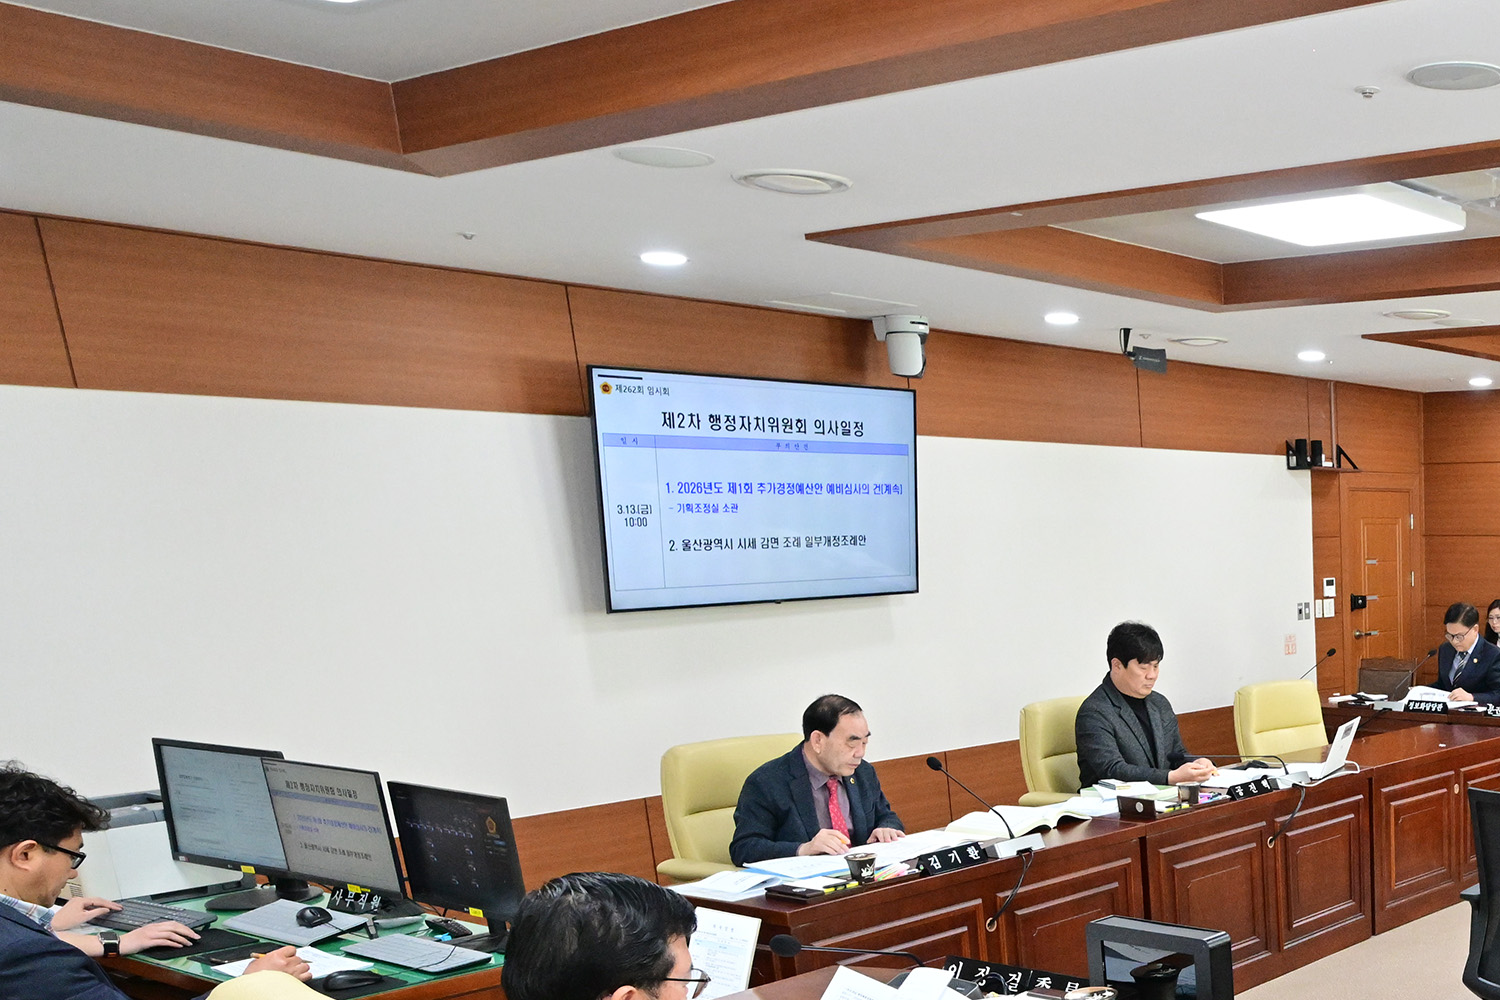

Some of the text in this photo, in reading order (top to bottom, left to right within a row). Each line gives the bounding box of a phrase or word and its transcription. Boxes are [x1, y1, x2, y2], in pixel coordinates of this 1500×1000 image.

[615, 384, 670, 396] 제262회 임시회
[661, 411, 864, 437] 제2차 행정자치위원회 의사일정
[666, 482, 674, 494] 1.
[677, 482, 723, 495] 2026년도
[727, 482, 753, 494] 제1회
[757, 482, 823, 495] 추가경정예산안
[826, 483, 870, 495] 예비심사의
[677, 503, 719, 513] 기획조정실
[722, 503, 739, 513] 소관
[624, 517, 648, 527] 10:00
[669, 535, 866, 552] 2. 울산광역시 시세 감면 조례 일부개정조례안
[928, 845, 981, 870] 김기환
[331, 889, 381, 911] 사무직원
